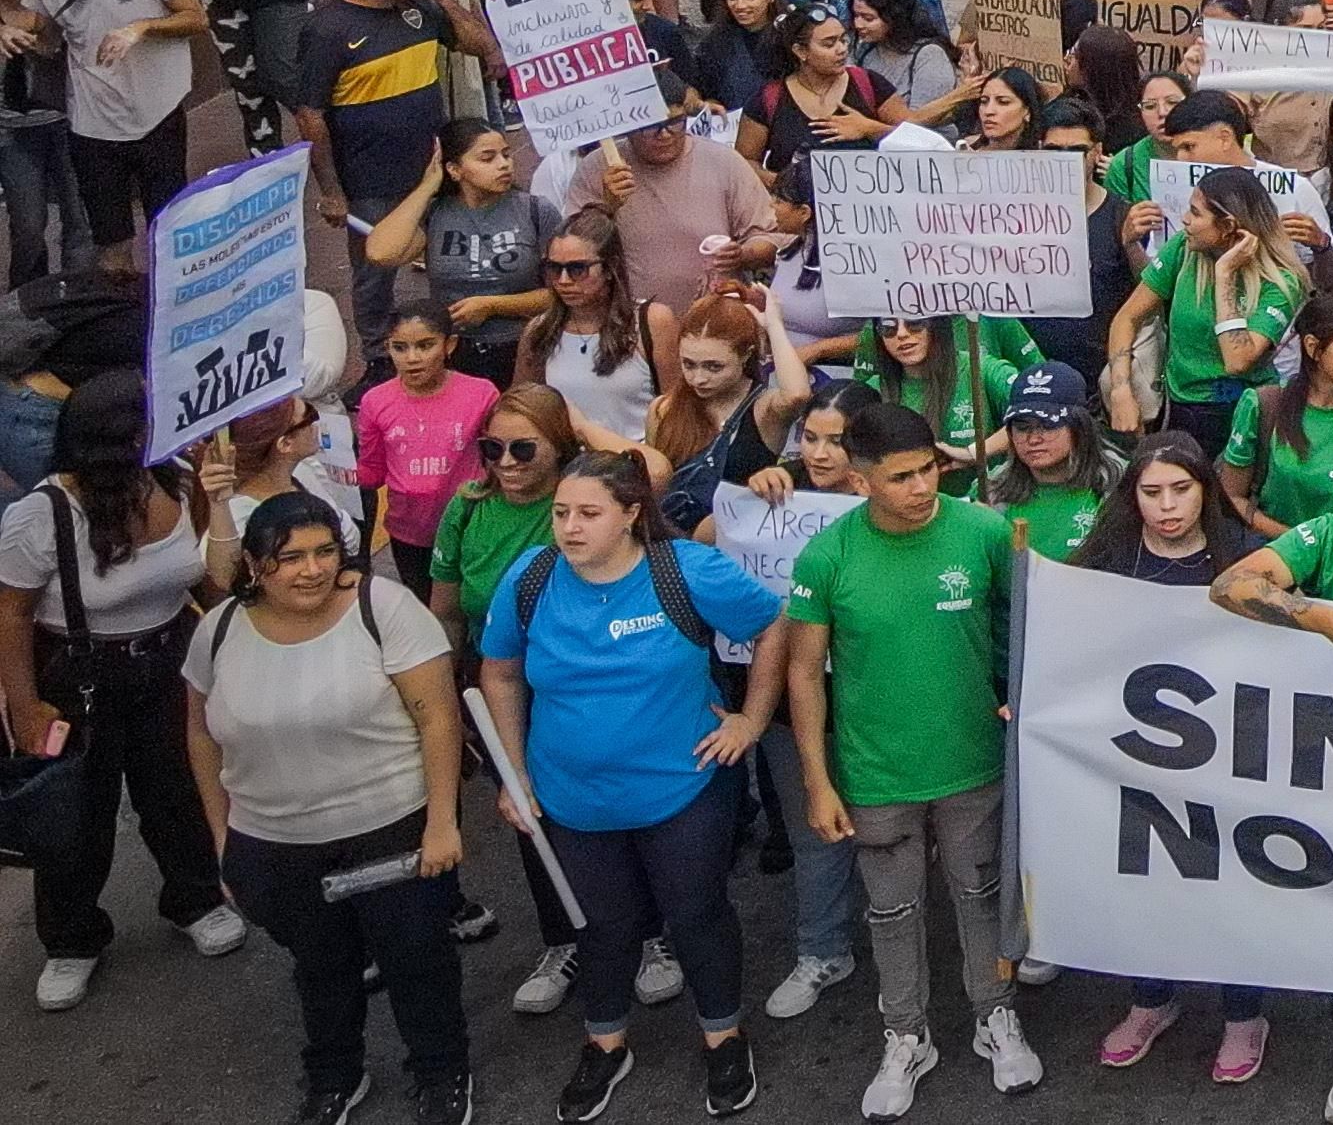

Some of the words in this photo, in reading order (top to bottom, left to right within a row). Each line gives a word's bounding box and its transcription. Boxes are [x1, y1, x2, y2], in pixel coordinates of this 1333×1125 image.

[506, 1, 592, 37] inclusiva
[977, 12, 1031, 39] NUESTROS
[514, 40, 532, 58] de
[540, 19, 605, 48] calidad
[1213, 25, 1272, 56] VIVA
[1286, 31, 1309, 58] LA
[515, 32, 645, 94] PUBLICA
[604, 82, 621, 105] y
[544, 108, 626, 150] gratuita
[811, 155, 848, 195] YO
[854, 155, 905, 195] SOY
[916, 157, 944, 194] LA
[953, 158, 1080, 196] ESTUDIANTE
[177, 178, 297, 255] DISCULPA
[817, 201, 847, 235] DE
[852, 202, 902, 235] UNA
[915, 202, 1072, 236] UNIVERSIDAD
[182, 259, 207, 276] LAS
[261, 210, 292, 238] ESTOY
[822, 241, 878, 275] SIN
[177, 230, 297, 302] DEFENDIENDO
[409, 456, 451, 476] GIRL
